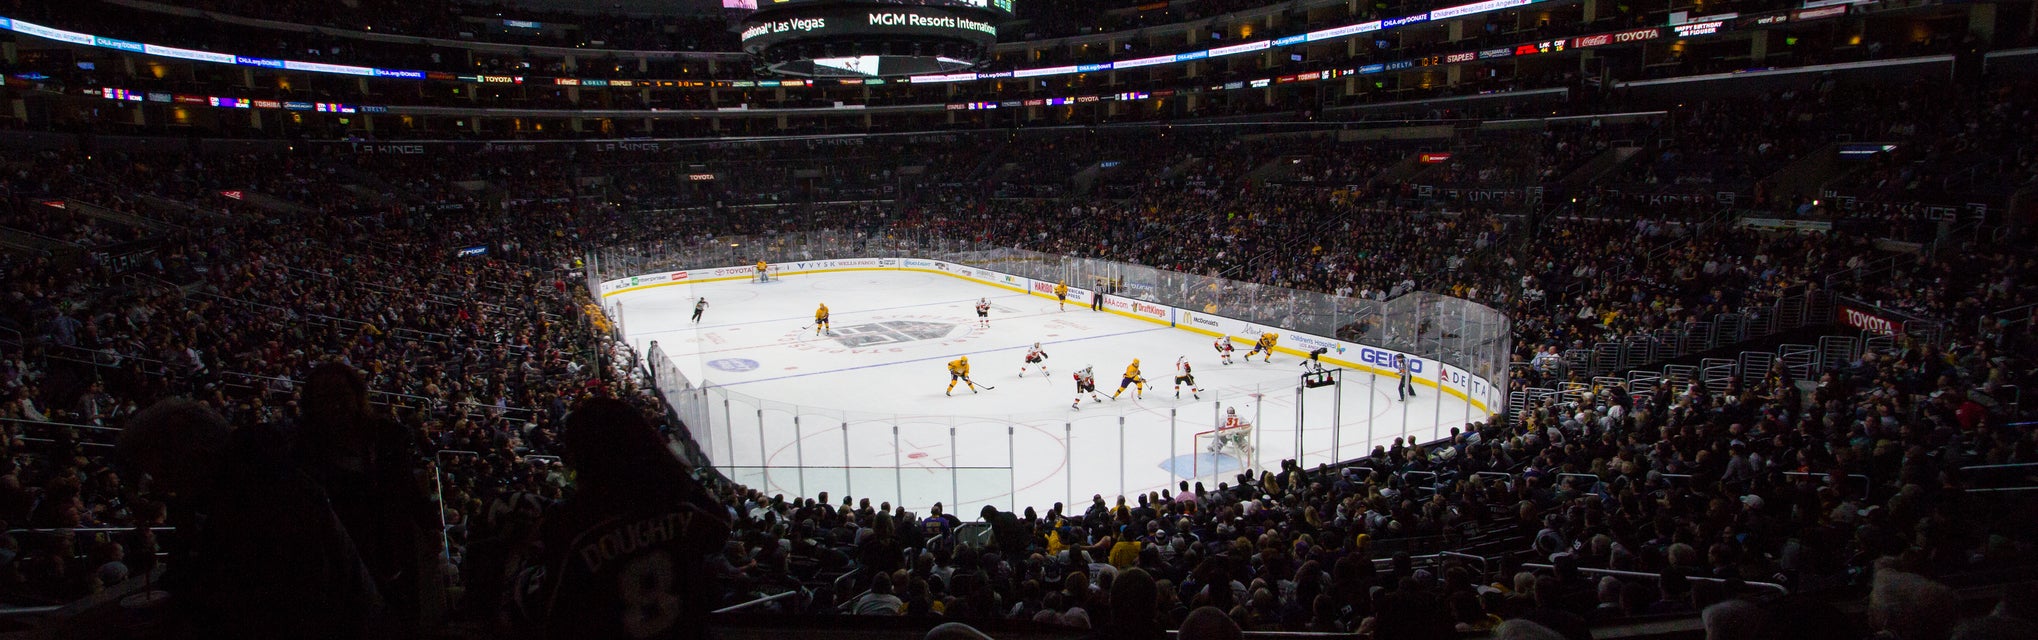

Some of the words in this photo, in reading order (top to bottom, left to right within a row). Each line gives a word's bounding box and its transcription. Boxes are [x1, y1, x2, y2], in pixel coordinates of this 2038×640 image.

[1433, 8, 1459, 18] Children's
[1460, 4, 1484, 13] Hospital
[773, 21, 789, 33] Las
[790, 18, 825, 32] Vegas
[870, 13, 906, 25] MGM
[910, 13, 955, 28] Resorts
[957, 17, 996, 36] International
[1694, 21, 1723, 30] BIRTHDAY
[1615, 29, 1659, 42] TOYOTA
[1447, 53, 1475, 63] STAPLES
[1391, 61, 1412, 69] DELTA
[254, 100, 281, 108] TOSHIBA
[378, 144, 424, 154] KINGS
[620, 142, 660, 152] KINGS
[725, 267, 752, 275] TOYOTA
[1034, 281, 1053, 294] HARIBO
[1104, 297, 1128, 309] AAA.com
[1138, 302, 1166, 318] DraftKings
[1193, 317, 1219, 328] McDonald's
[1846, 308, 1893, 338] TOYOTA
[1290, 334, 1314, 345] Children's
[1314, 339, 1337, 350] Hospital
[1452, 371, 1487, 396] DETA
[578, 510, 695, 575] DOUGHTY
[620, 550, 681, 638] 8
